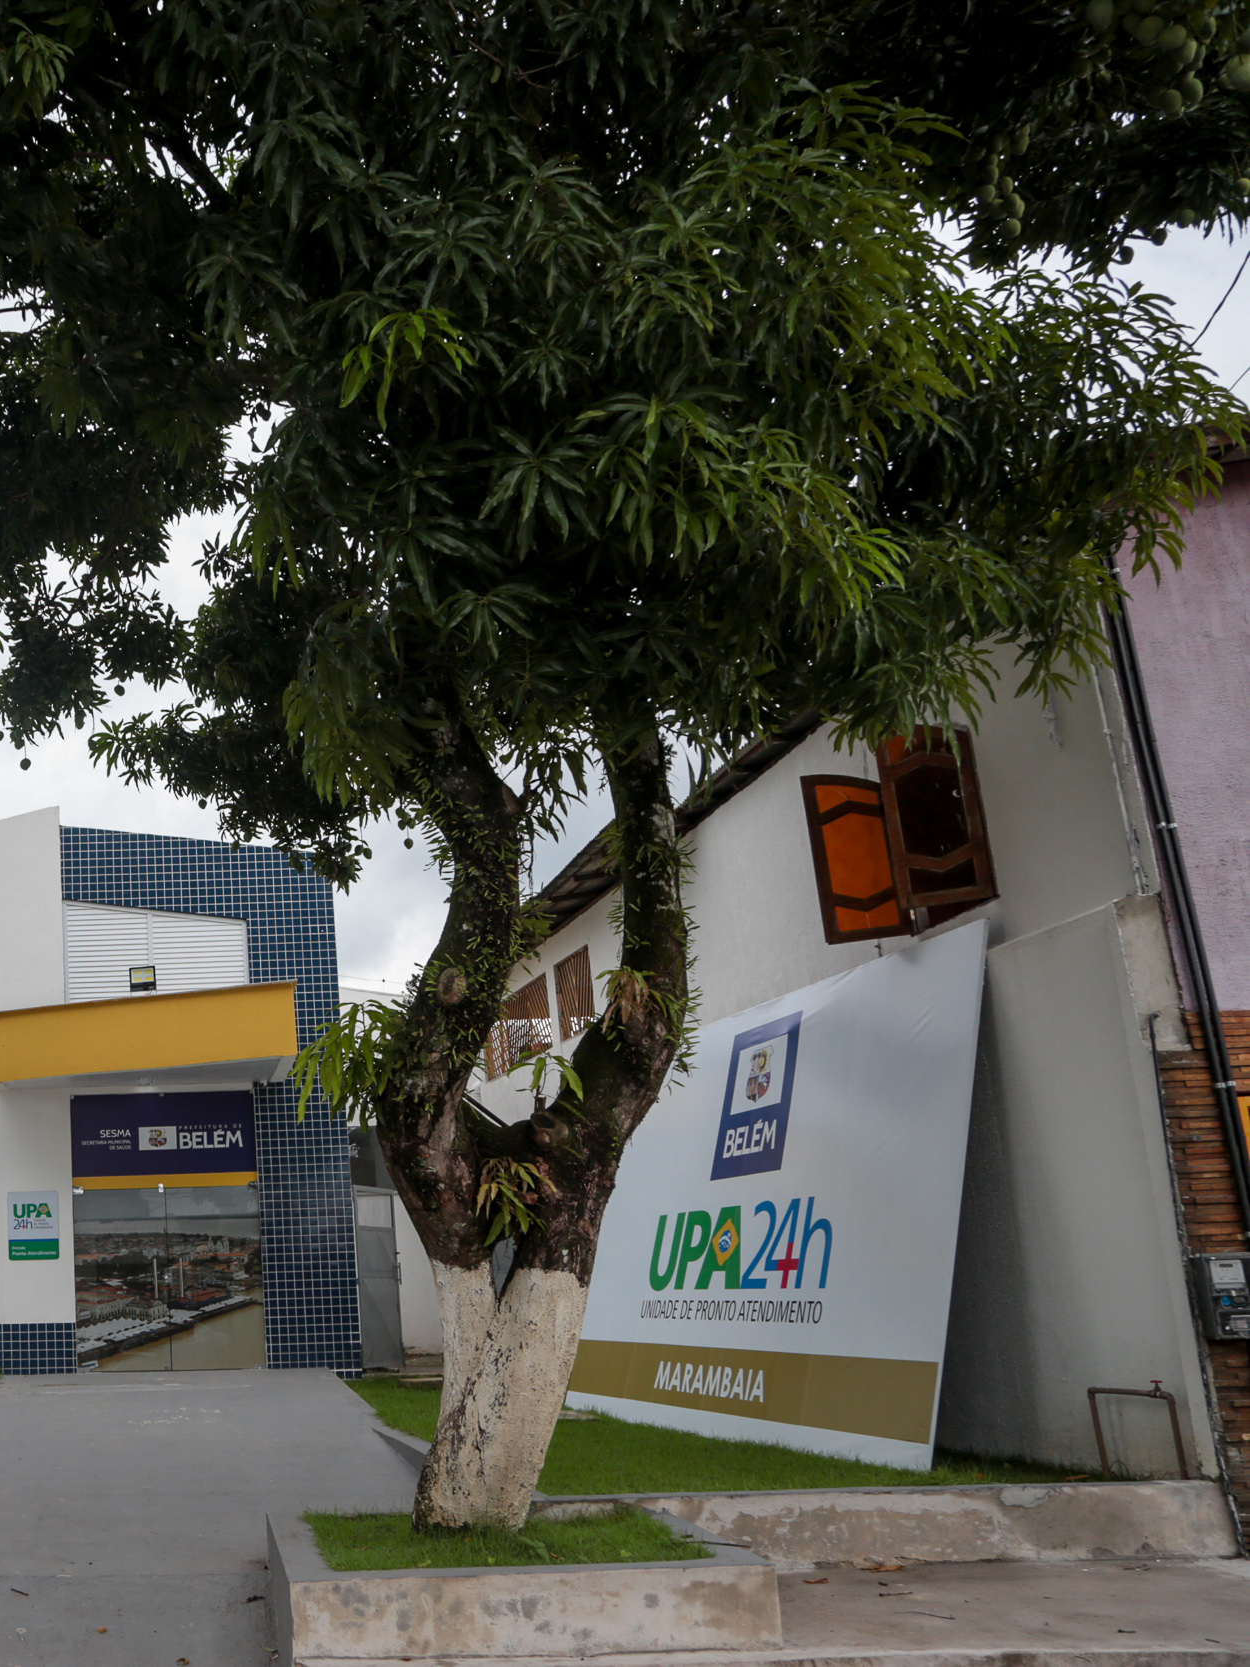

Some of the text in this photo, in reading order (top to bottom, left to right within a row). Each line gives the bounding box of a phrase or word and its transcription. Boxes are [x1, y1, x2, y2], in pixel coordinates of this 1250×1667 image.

[100, 1129, 131, 1138] SESMA
[178, 1129, 244, 1149] BELÉM
[722, 1119, 777, 1159] BELÉM
[13, 1202, 52, 1219] UPA
[13, 1219, 33, 1230] 24h
[640, 1299, 823, 1324] UNIDADE DE PRONTO ATENDIMENTO
[654, 1360, 765, 1403] MARAMBAIA
